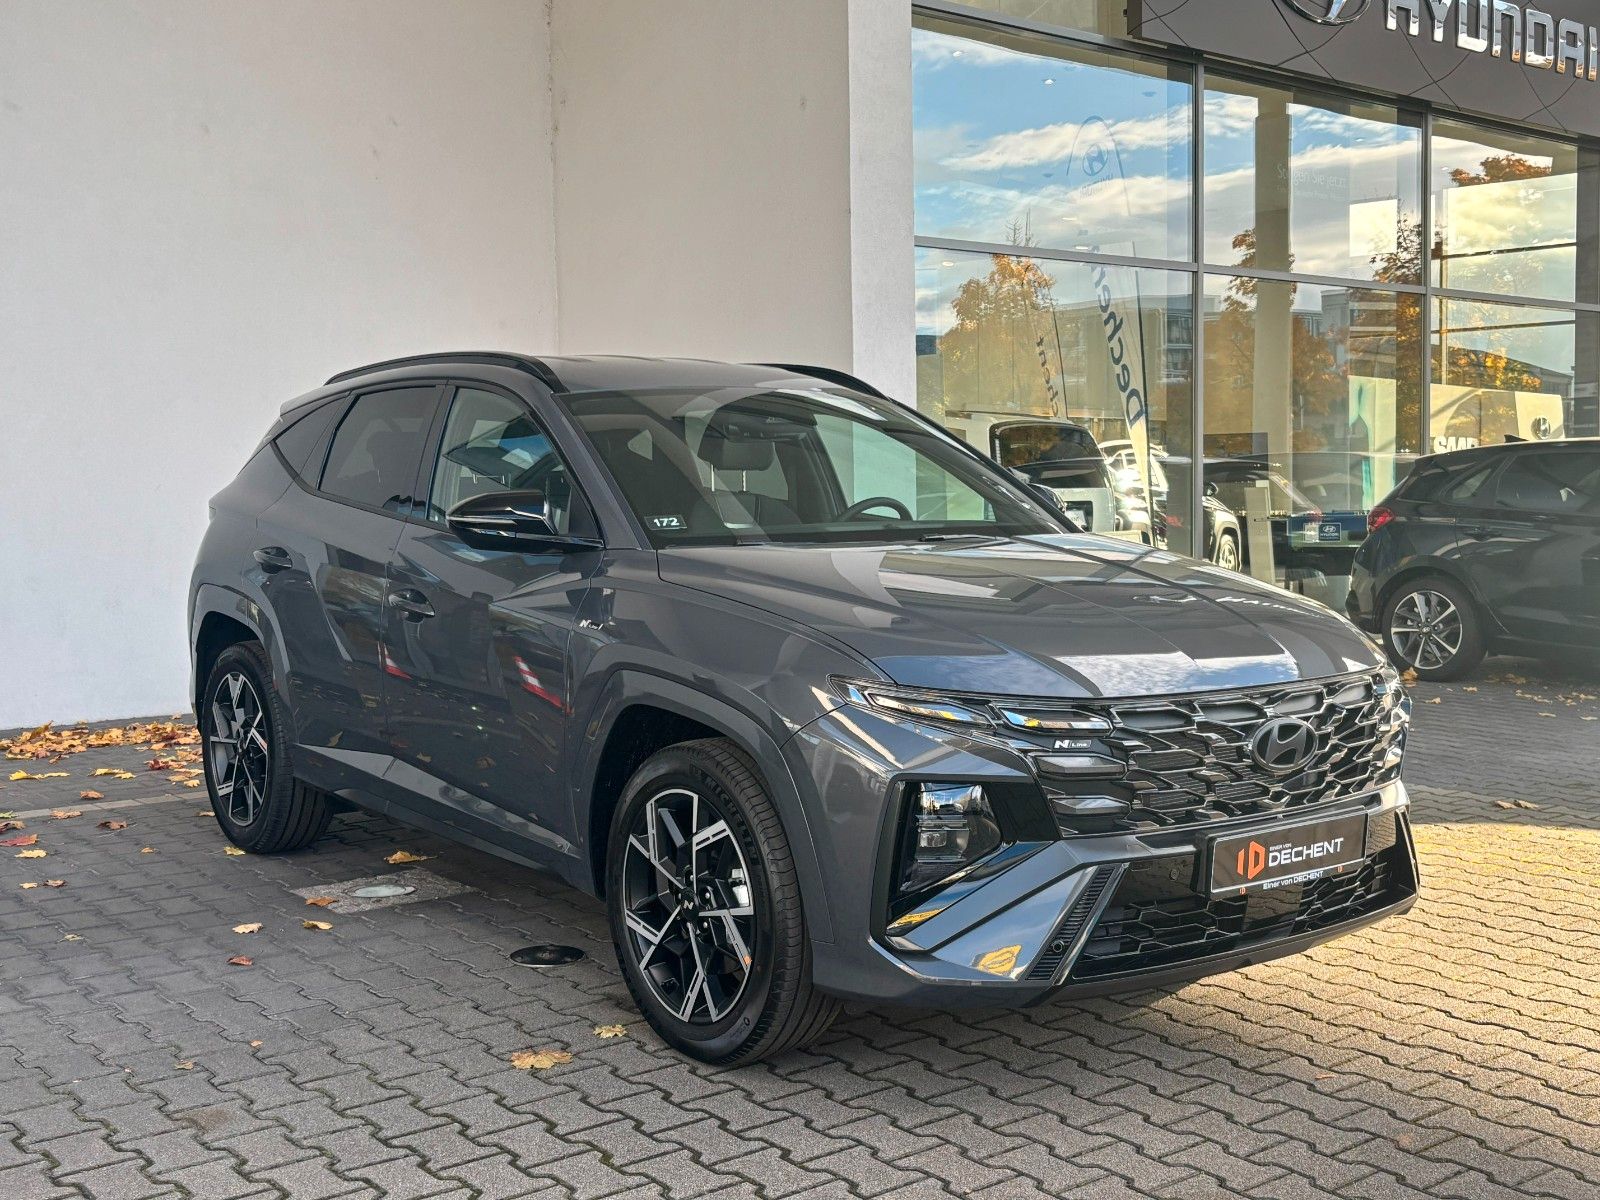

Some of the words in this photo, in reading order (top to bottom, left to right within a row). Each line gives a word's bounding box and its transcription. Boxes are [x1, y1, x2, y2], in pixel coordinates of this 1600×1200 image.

[653, 517, 680, 527] 172
[1054, 740, 1069, 748] N
[1268, 838, 1344, 868] DECHENT
[1262, 882, 1280, 890] Einer
[1280, 878, 1293, 886] von
[1293, 871, 1324, 884] DECHENT
